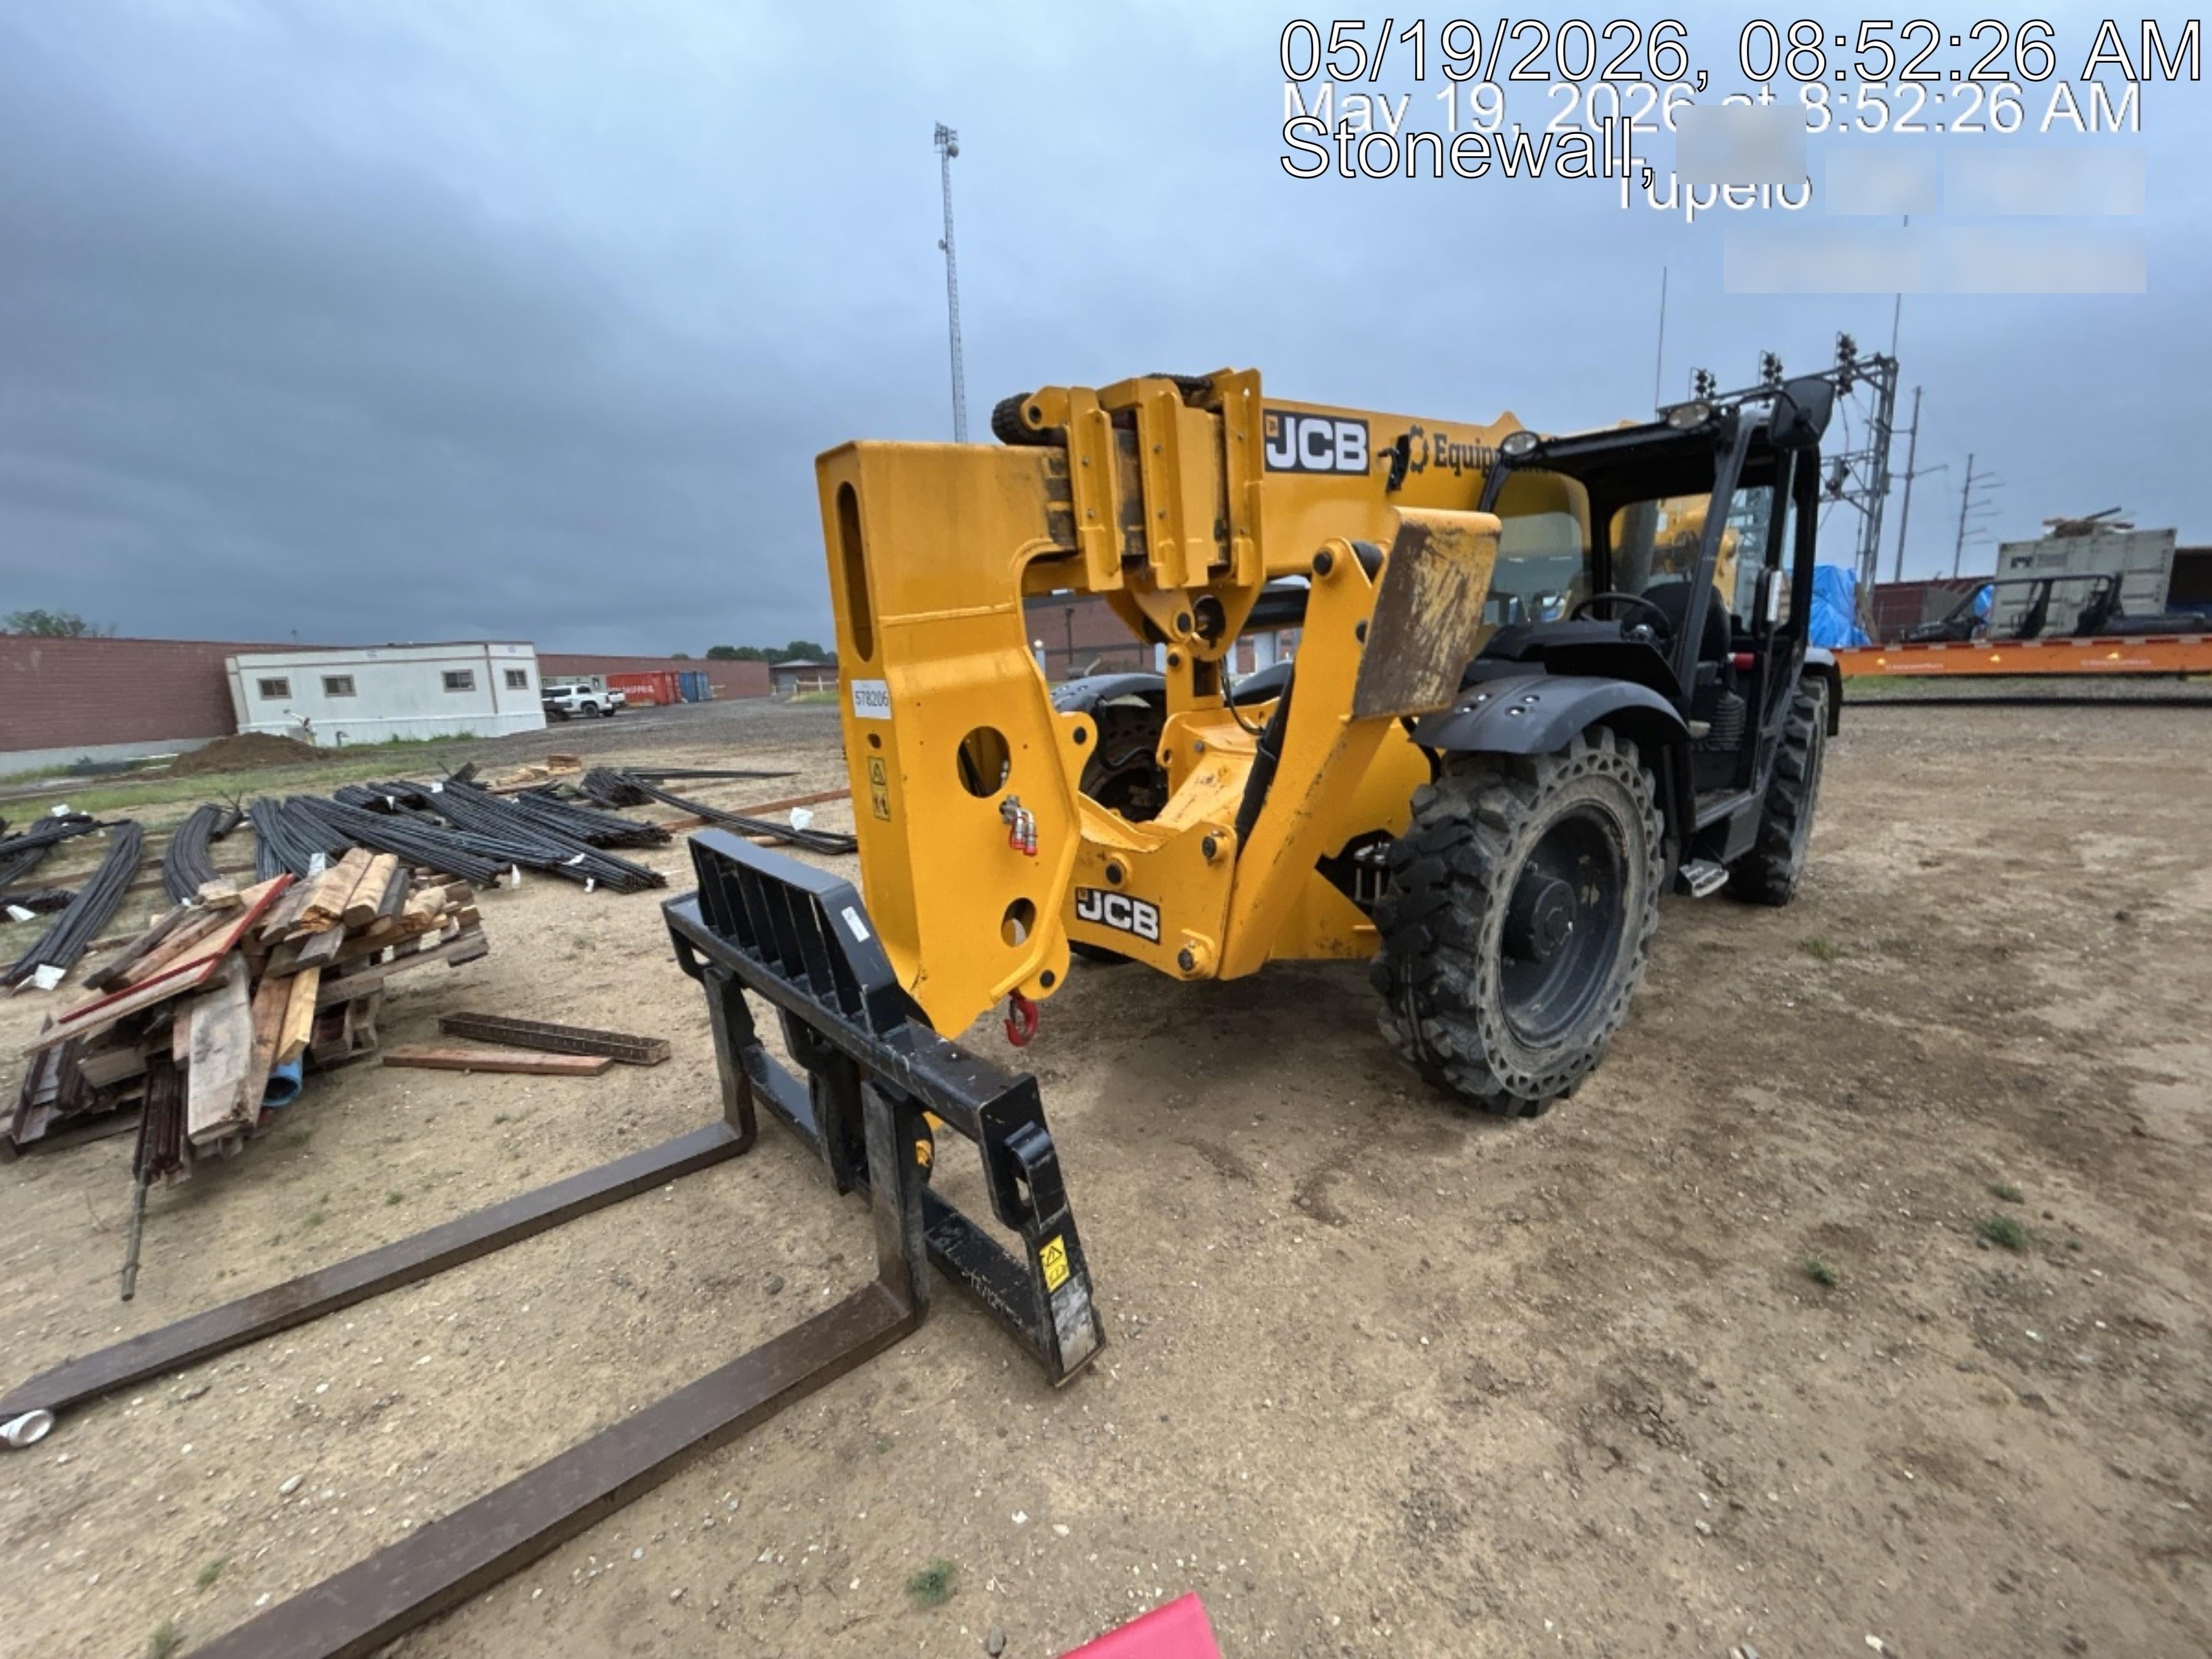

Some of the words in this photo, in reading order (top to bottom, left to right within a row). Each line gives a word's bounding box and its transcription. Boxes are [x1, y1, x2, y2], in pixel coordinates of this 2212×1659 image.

[1266, 415, 1368, 471] JCB
[1433, 432, 1501, 478] Equip
[1077, 890, 1159, 941] JCB
